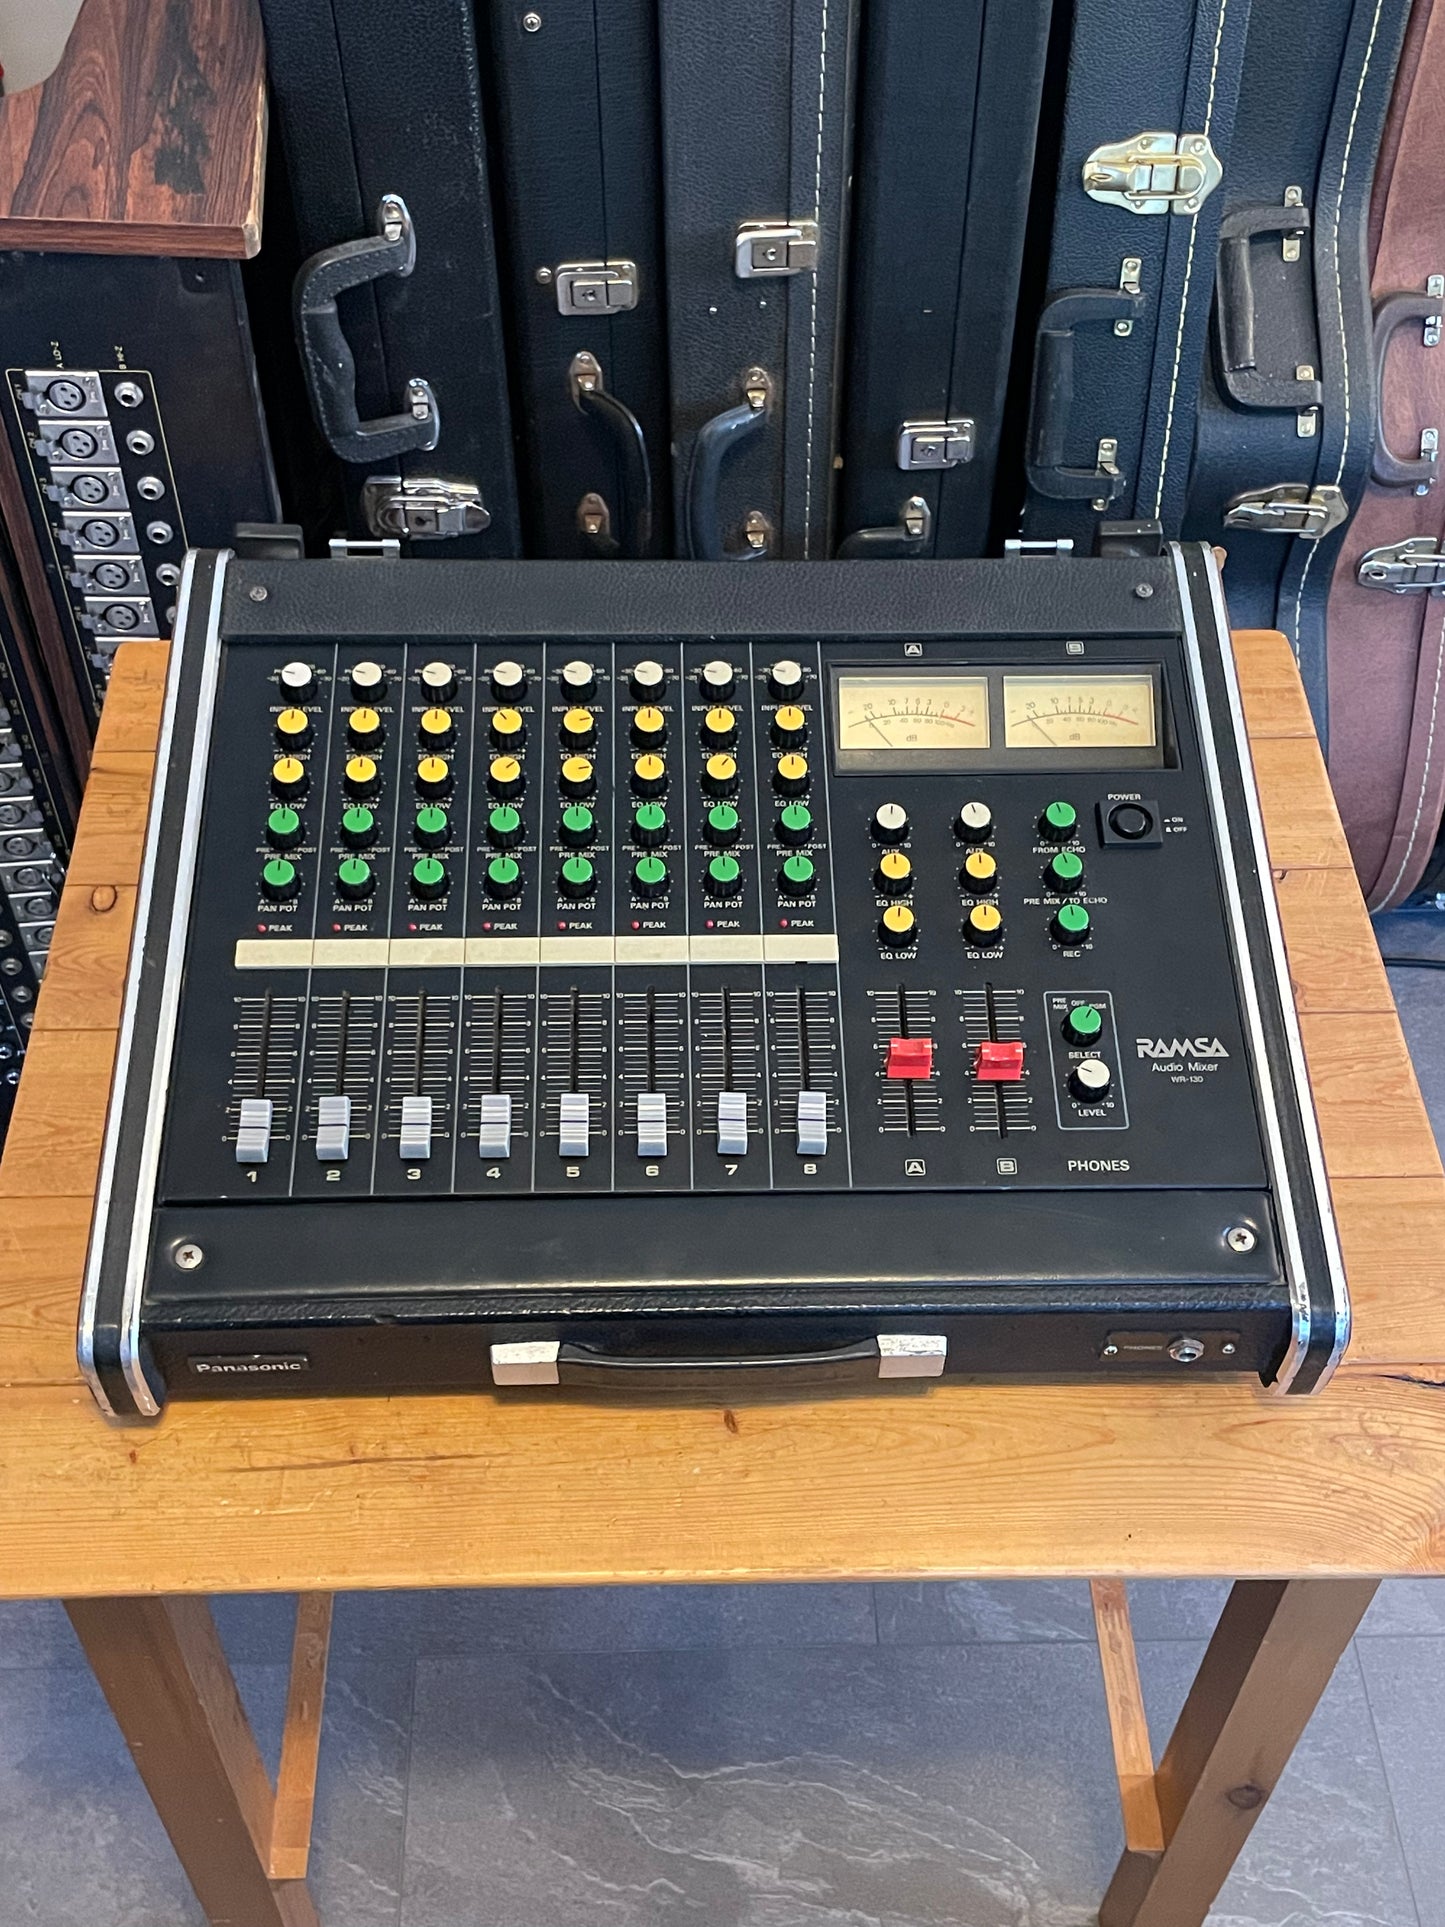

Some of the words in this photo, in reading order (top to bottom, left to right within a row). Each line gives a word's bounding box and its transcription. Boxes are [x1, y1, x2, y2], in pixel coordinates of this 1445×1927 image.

[1136, 1037, 1229, 1058] RAMSA
[1152, 1062, 1183, 1072] Audio
[1188, 1062, 1218, 1071] Mixer
[566, 1166, 580, 1177] 5
[645, 1165, 659, 1176] 6
[724, 1165, 738, 1176] 7
[804, 1164, 817, 1175] 8
[1067, 1160, 1130, 1172] PHONES
[247, 1171, 257, 1182] 1
[326, 1170, 341, 1181] 2
[407, 1169, 421, 1180] 3
[486, 1167, 501, 1179] 4
[196, 1361, 301, 1372] Panasonic
